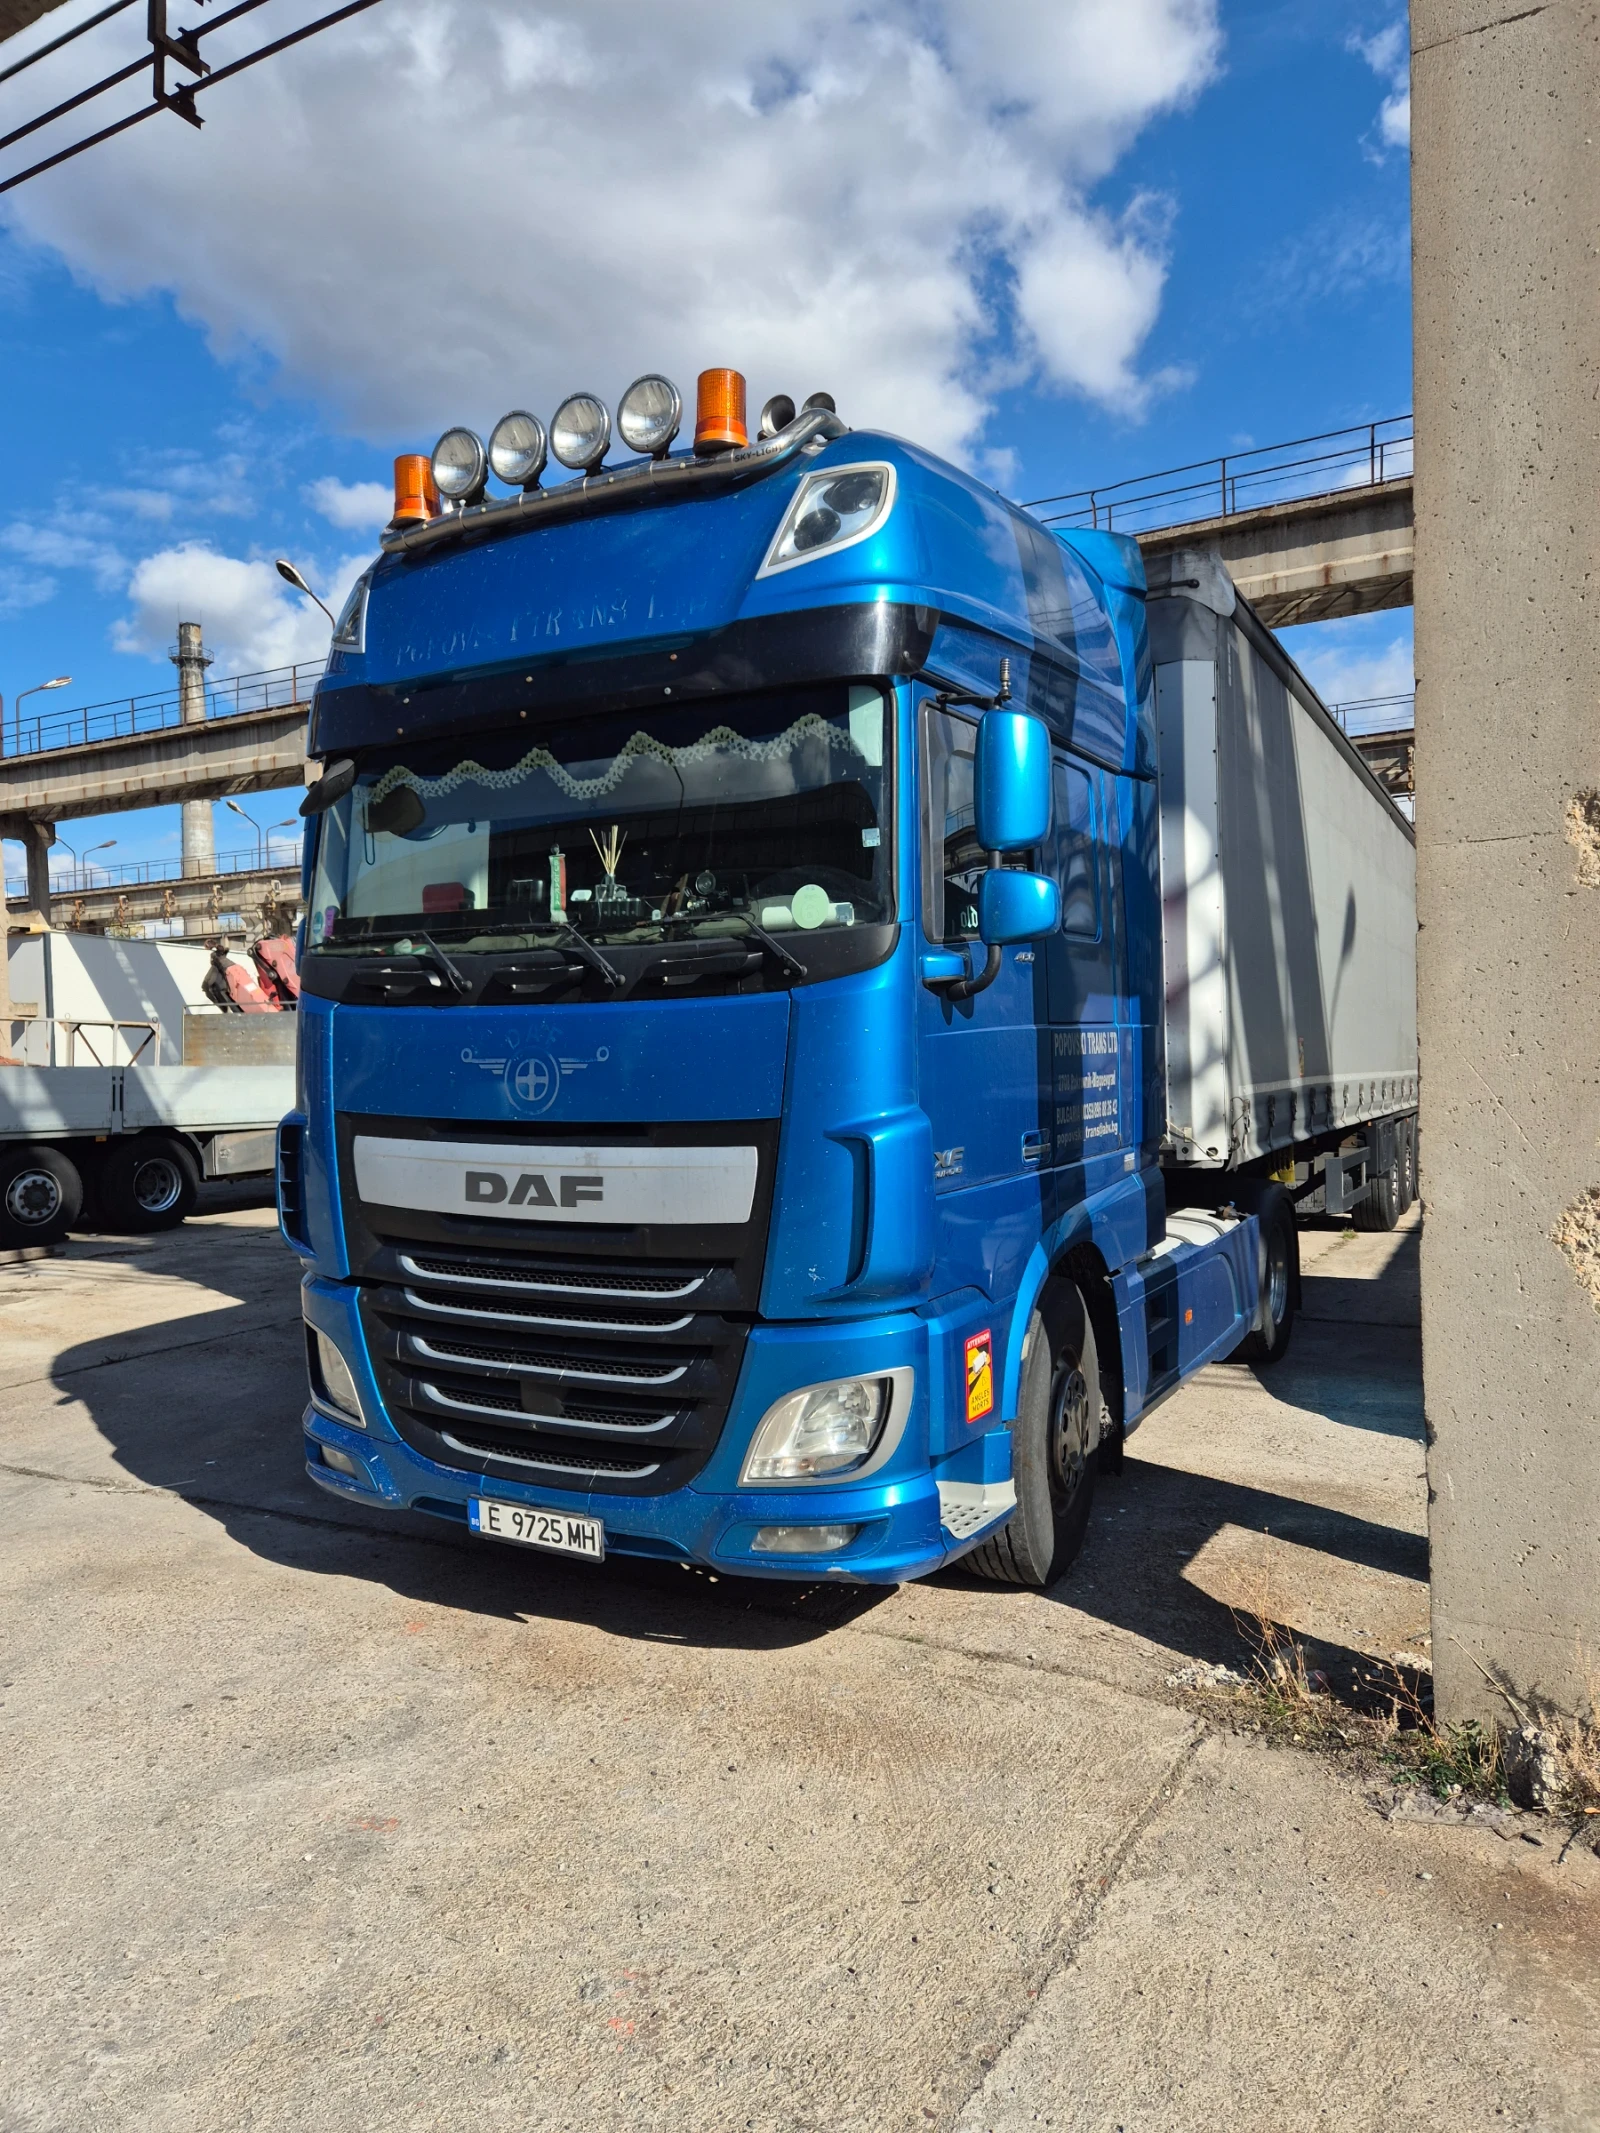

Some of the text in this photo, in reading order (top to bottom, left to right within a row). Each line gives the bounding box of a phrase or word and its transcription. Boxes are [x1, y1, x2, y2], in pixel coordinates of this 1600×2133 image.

[1054, 1031, 1118, 1056] POPOVSKI TRANS LTD
[934, 1146, 964, 1168] XF
[465, 1171, 603, 1208] DAF
[971, 1388, 990, 1405] ANGLES
[972, 1398, 990, 1412] MORTS
[488, 1506, 501, 1532] E
